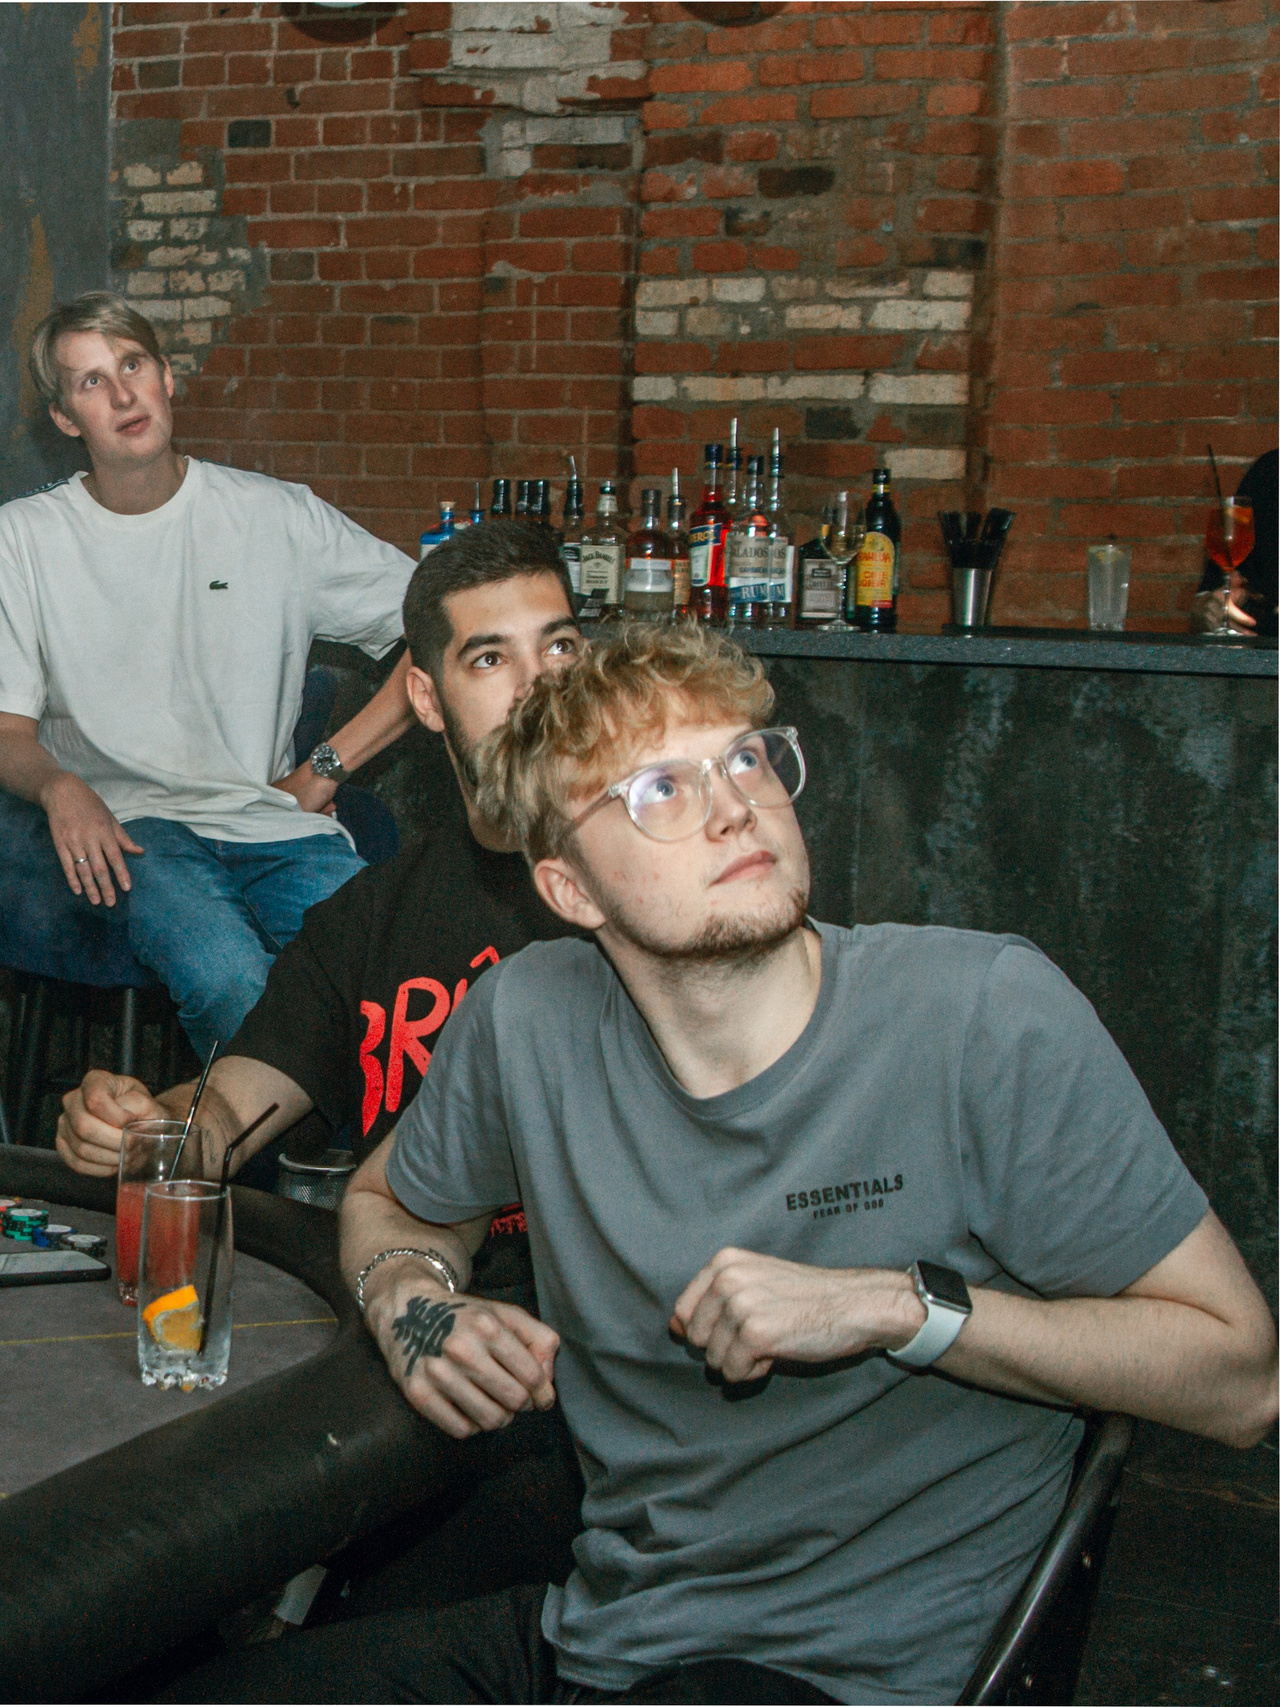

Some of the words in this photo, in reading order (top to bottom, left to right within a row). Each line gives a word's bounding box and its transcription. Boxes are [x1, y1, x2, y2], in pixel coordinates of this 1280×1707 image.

[786, 1173, 904, 1211] ESSENTIALS
[813, 1205, 841, 1219] FEAR
[845, 1203, 859, 1213] OF
[864, 1198, 885, 1211] GOD
